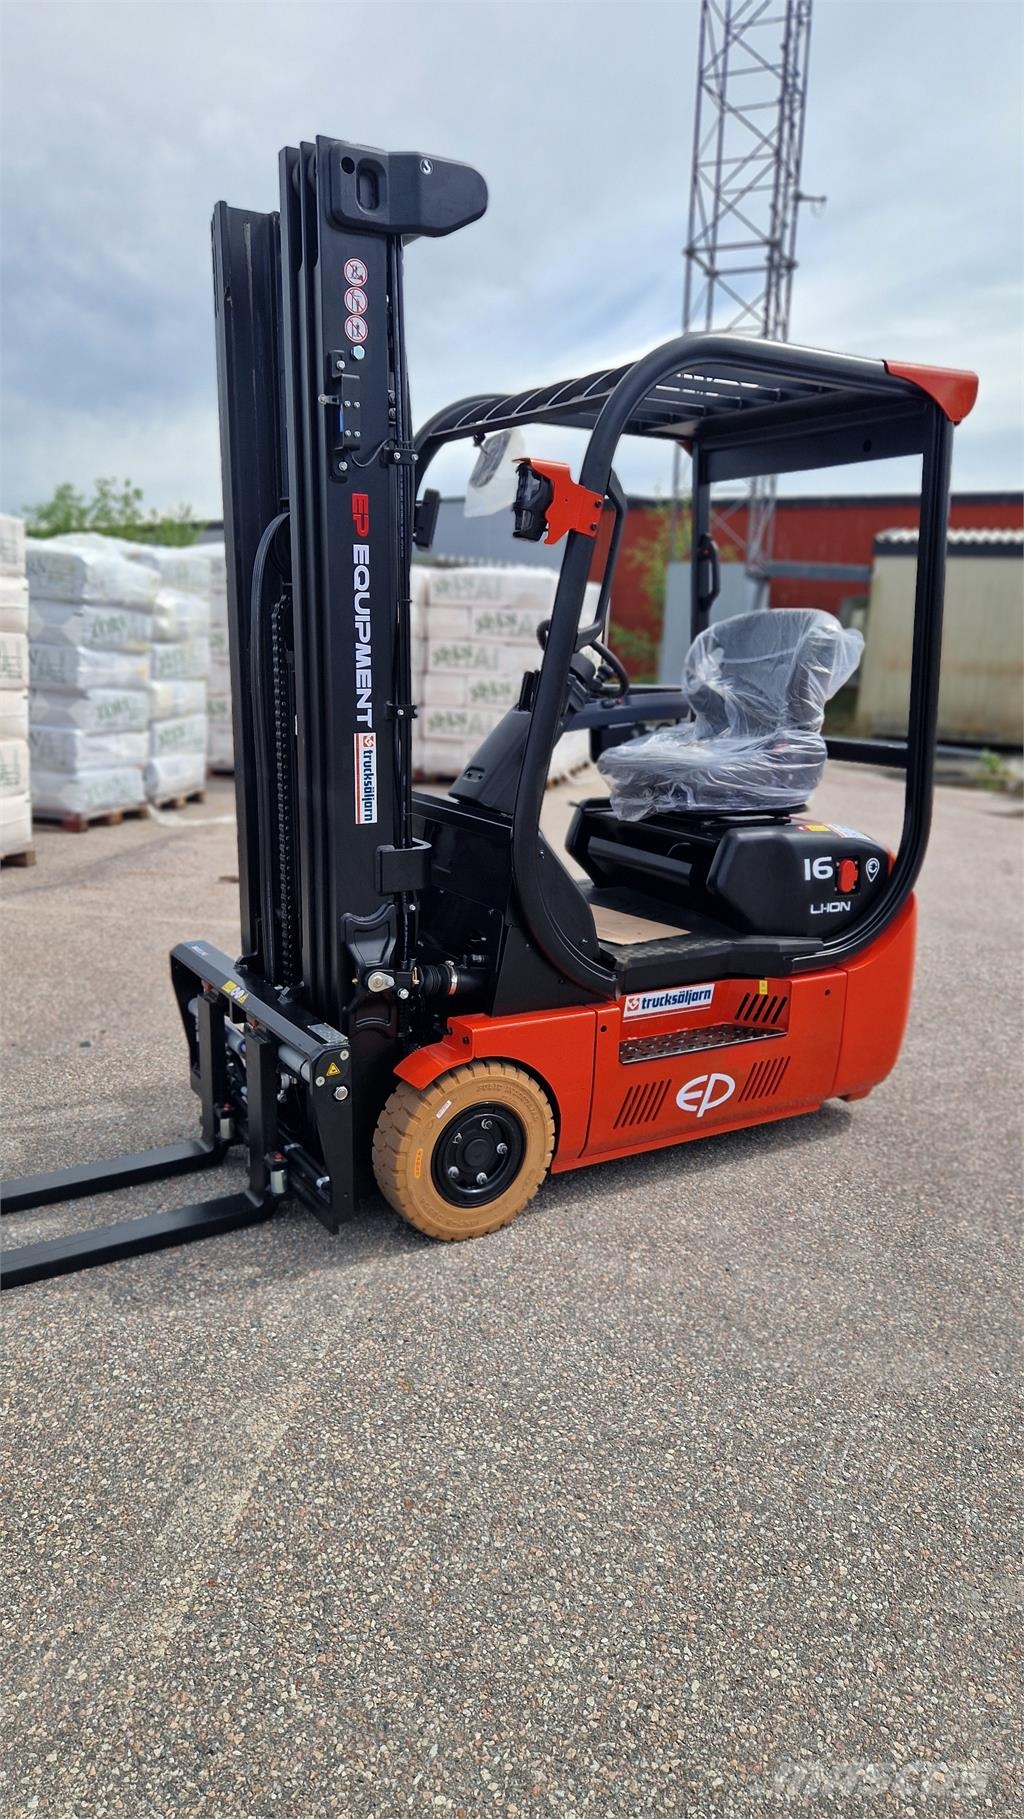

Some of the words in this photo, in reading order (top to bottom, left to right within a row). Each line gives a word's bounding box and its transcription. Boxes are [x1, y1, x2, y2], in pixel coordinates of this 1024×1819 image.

[352, 493, 370, 537] EP
[353, 544, 373, 728] EQUIPMENT
[361, 749, 375, 821] trucksäljarn
[803, 856, 834, 881] 16
[641, 989, 712, 1010] trucksäljarn
[675, 1073, 736, 1118] EP
